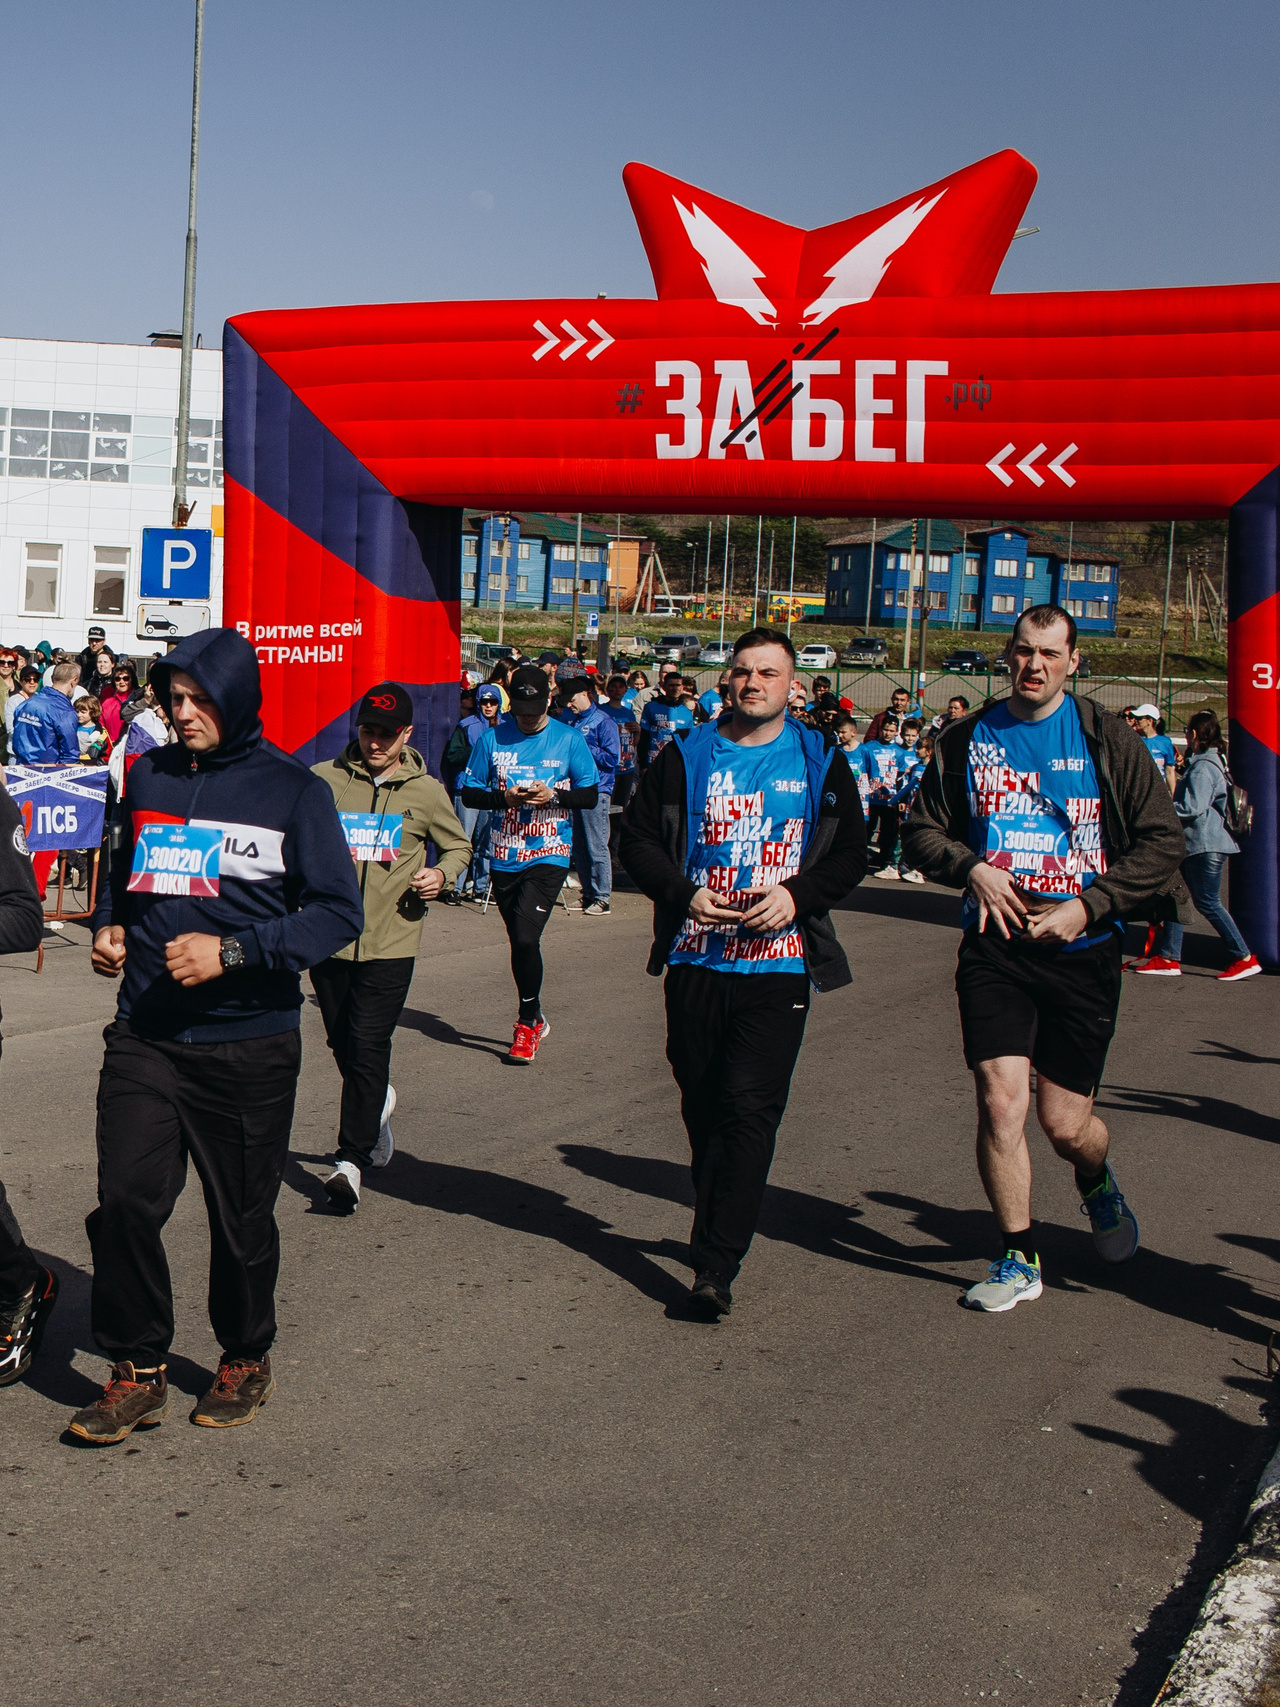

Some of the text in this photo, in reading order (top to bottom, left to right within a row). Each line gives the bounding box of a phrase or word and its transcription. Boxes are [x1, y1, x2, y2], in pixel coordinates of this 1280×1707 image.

[163, 539, 197, 589] P
[255, 624, 314, 641] ритме
[319, 619, 363, 638] всей
[589, 613, 598, 626] P
[1252, 663, 1280, 690] З
[492, 752, 519, 766] 2024
[37, 805, 78, 834] ПСБ
[224, 837, 260, 859] ILA
[1004, 830, 1055, 853] 30050
[148, 846, 203, 874] 30020
